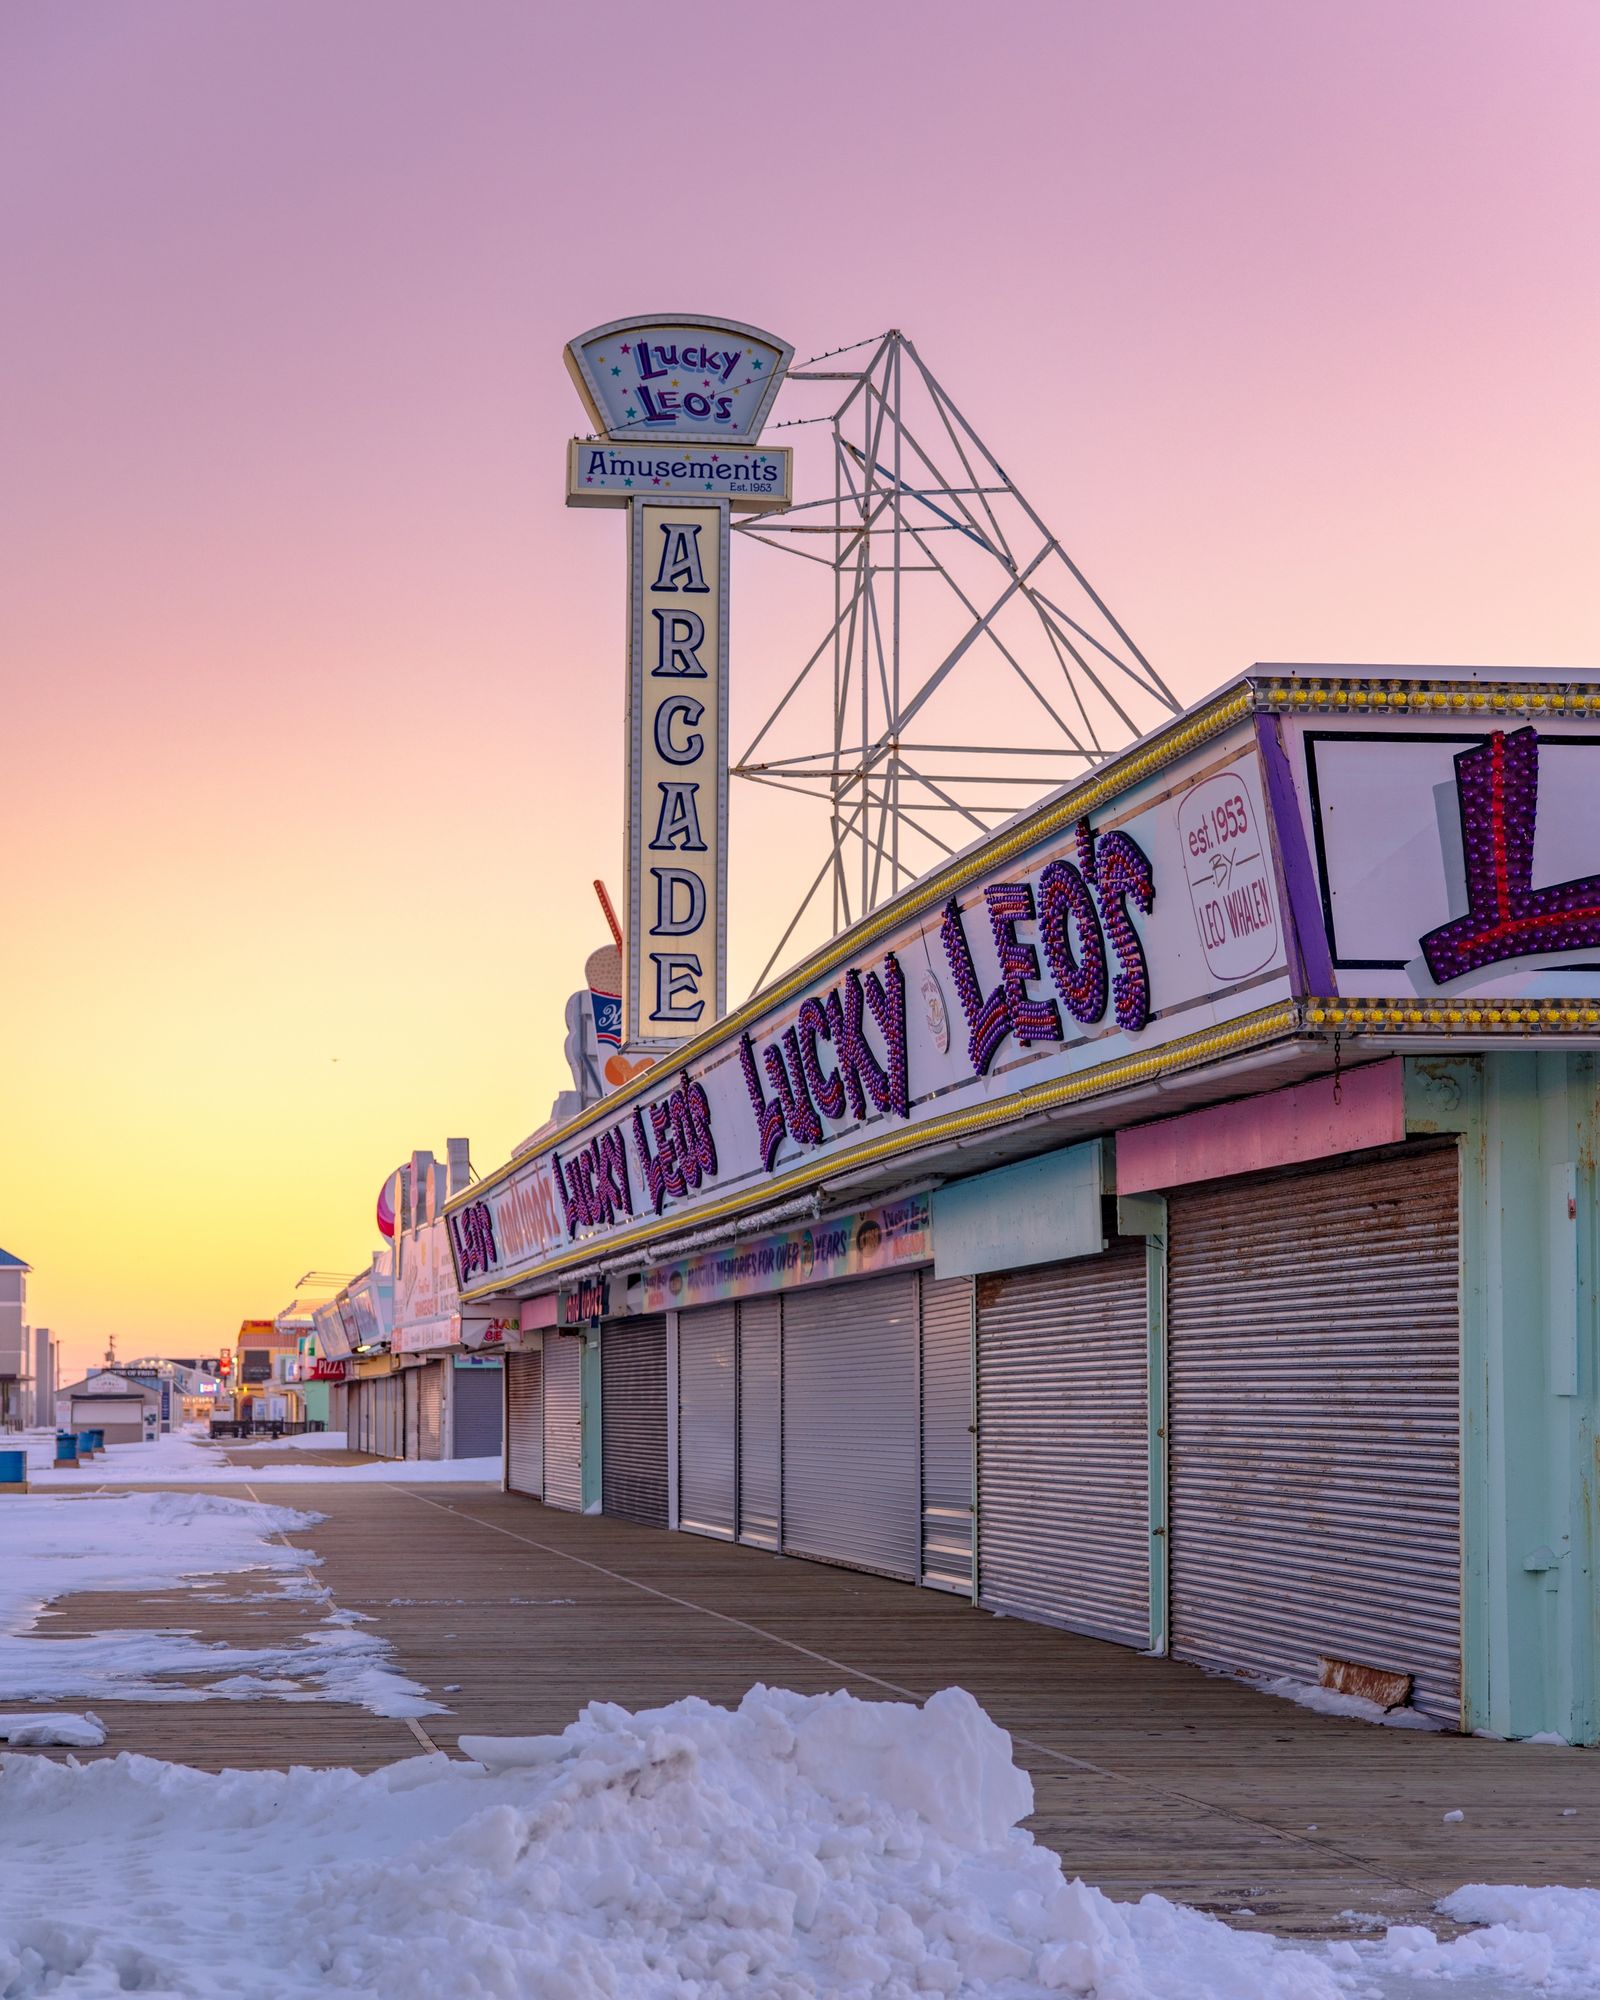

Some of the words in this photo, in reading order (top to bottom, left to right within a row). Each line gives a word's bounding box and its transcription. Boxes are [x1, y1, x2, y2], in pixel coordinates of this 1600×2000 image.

[588, 451, 778, 482] Amusements
[729, 482, 747, 492] Est.
[750, 483, 772, 493] 1953
[648, 523, 710, 1022] ARCADE
[1188, 814, 1214, 857] est.
[1211, 795, 1248, 845] 1953
[1209, 847, 1236, 891] BY
[1199, 899, 1226, 950] LEO
[1223, 877, 1273, 939] WHALEN
[740, 951, 909, 1172] LUCKY
[757, 1247, 775, 1275] FOR
[775, 1241, 799, 1272] OVER
[815, 1230, 847, 1263] YEARS
[318, 1360, 344, 1375] PIZZA
